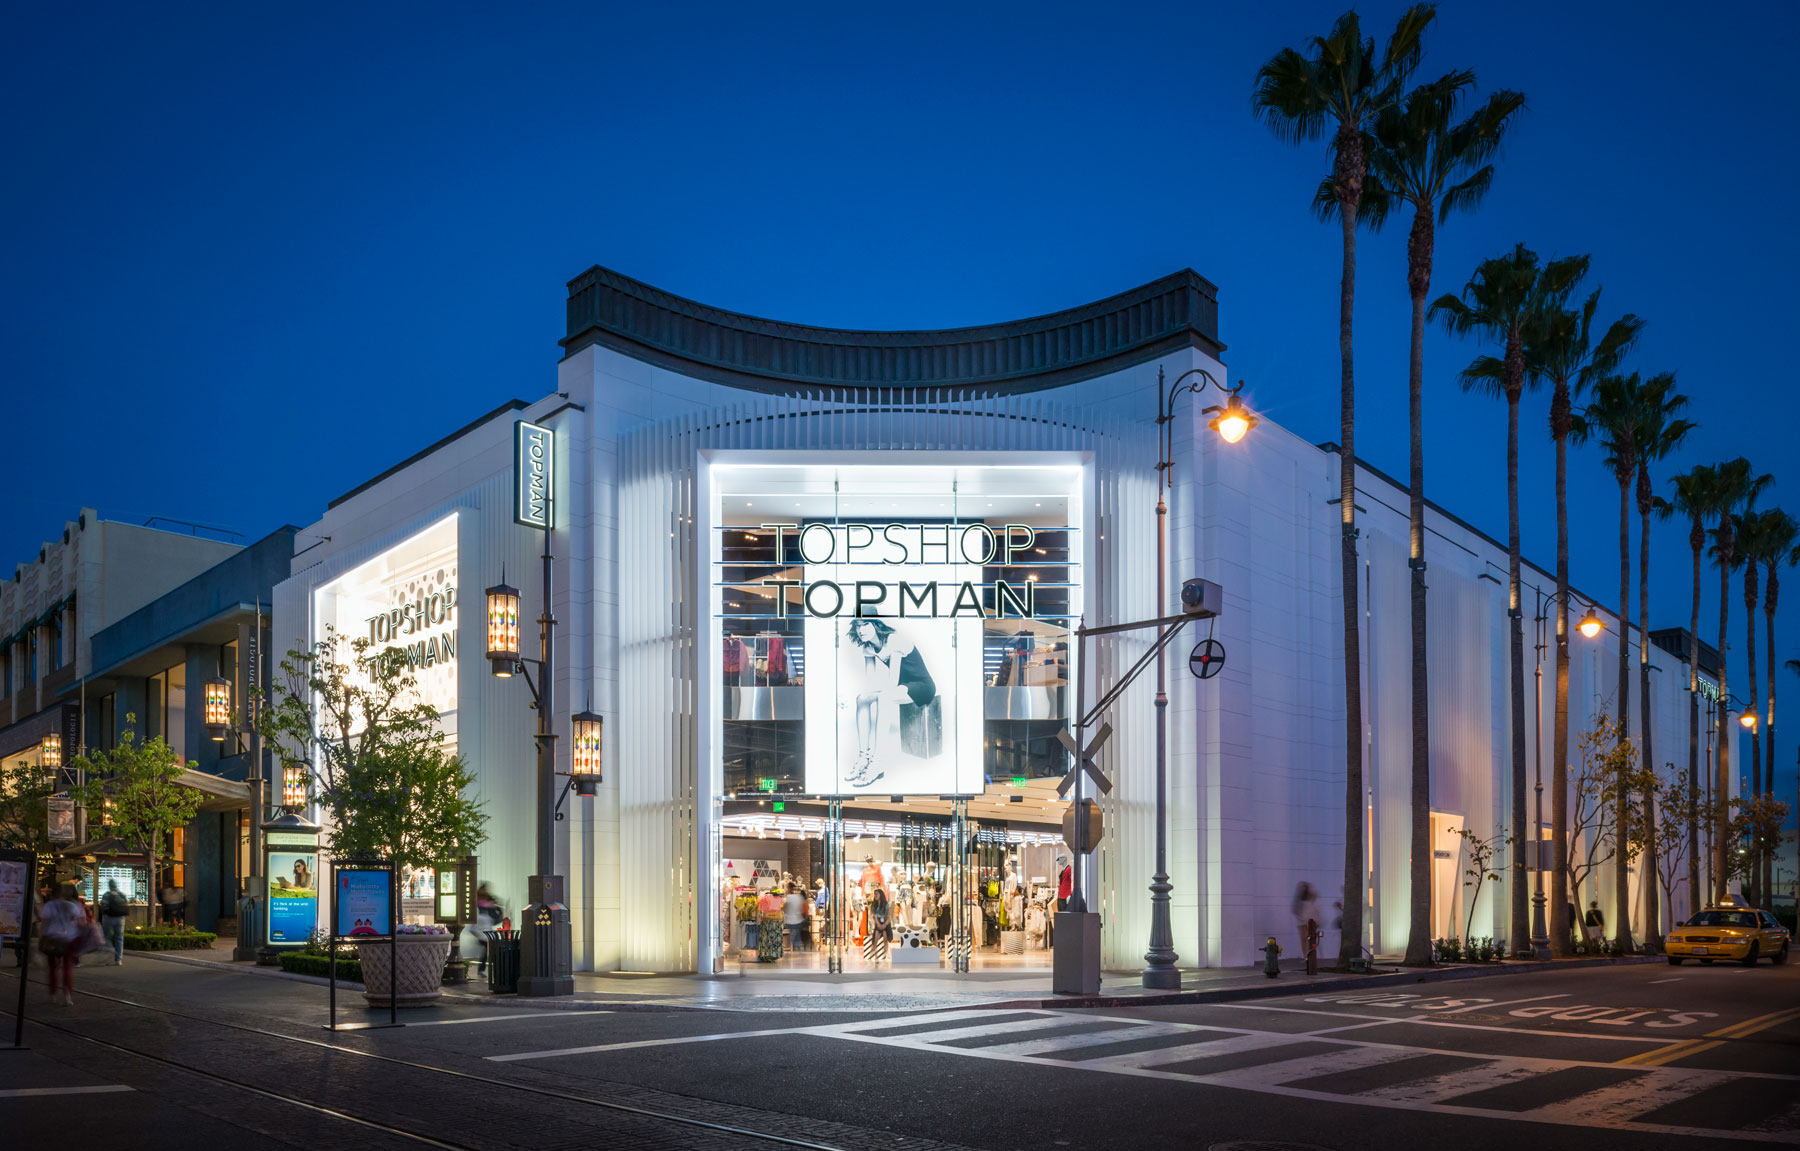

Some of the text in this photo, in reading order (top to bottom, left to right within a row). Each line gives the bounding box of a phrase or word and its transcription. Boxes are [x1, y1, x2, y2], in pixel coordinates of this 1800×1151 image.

[530, 433, 544, 520] TOPMAN
[761, 523, 1035, 566] TOPSHOP
[365, 587, 457, 647] TOPSHOP
[762, 580, 1034, 619] TOPMAN
[1508, 1005, 1720, 1028] STOP
